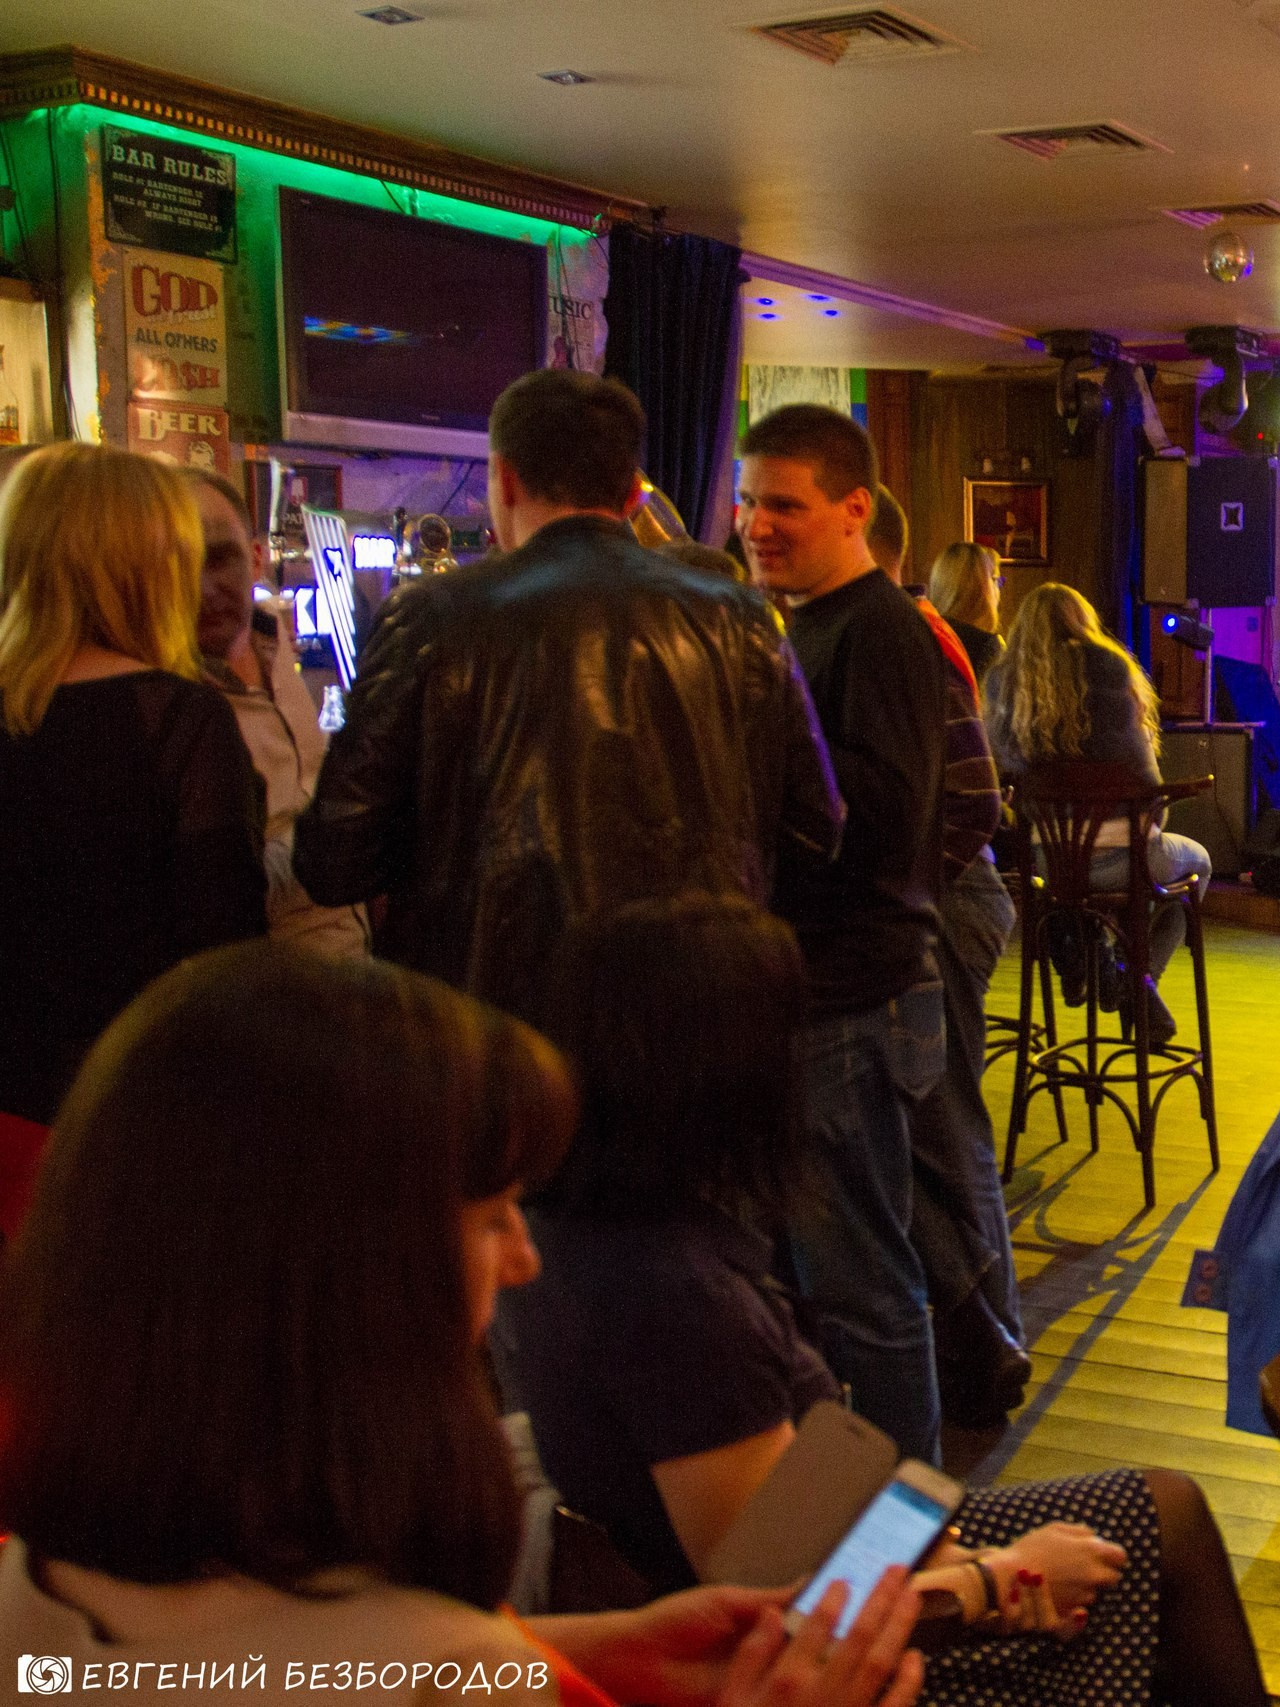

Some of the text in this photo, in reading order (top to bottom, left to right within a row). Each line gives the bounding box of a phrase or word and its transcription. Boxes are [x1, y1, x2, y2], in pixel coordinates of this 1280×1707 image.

[112, 144, 227, 186] BAR RULES
[131, 263, 218, 318] GOD
[135, 327, 218, 354] ALL OTHERS
[137, 408, 222, 440] BEER
